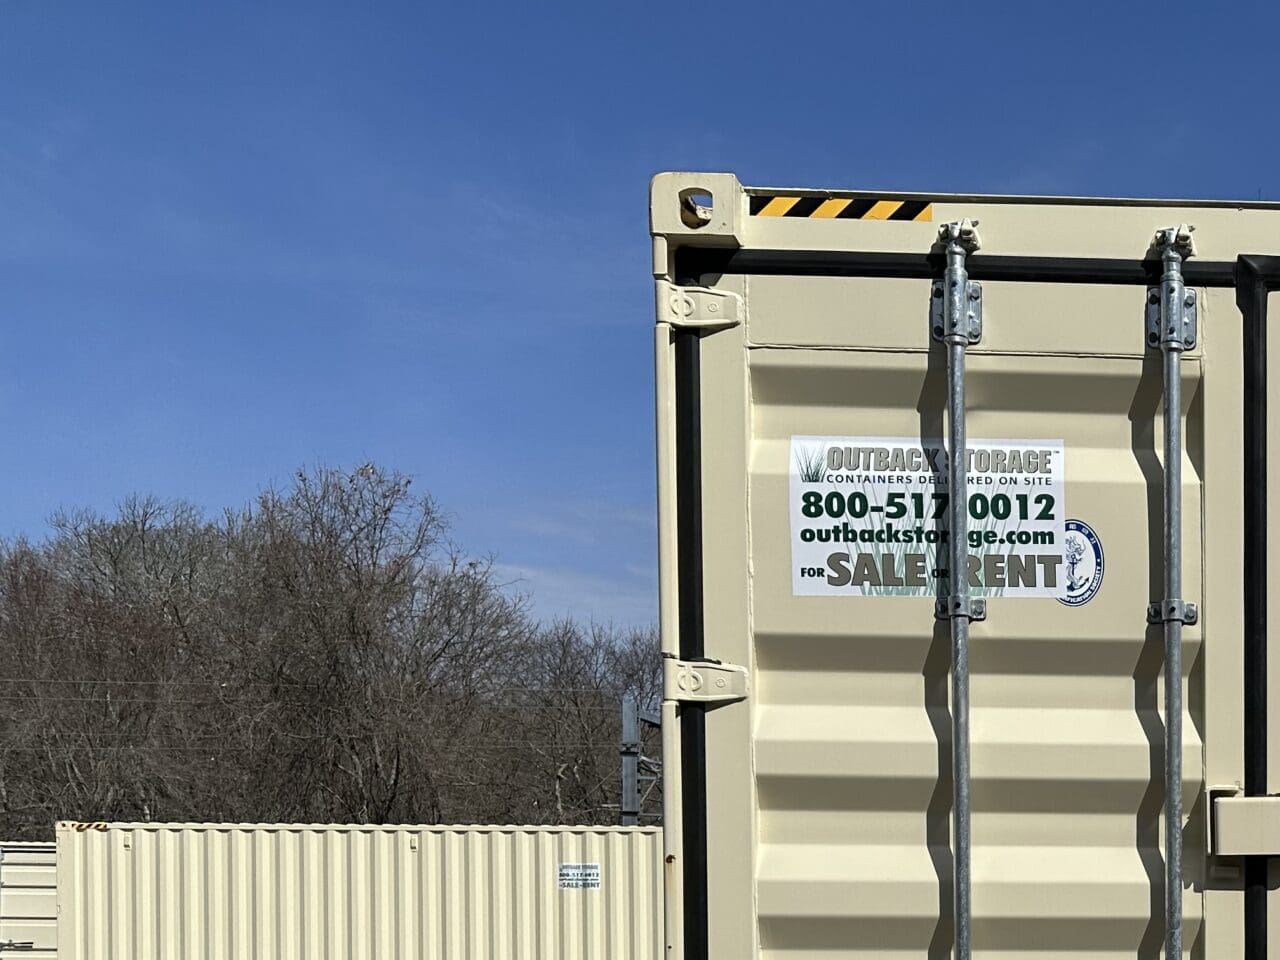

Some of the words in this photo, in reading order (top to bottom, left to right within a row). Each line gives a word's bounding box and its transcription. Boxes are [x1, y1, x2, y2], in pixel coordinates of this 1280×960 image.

[827, 446, 940, 473] OUTBACK
[944, 447, 1051, 474] TORAGE
[826, 474, 913, 485] CONTAINERS
[919, 475, 993, 485] DELIRED
[999, 476, 1018, 486] ON
[1024, 477, 1053, 487] SITE
[801, 491, 1055, 521] 800-5170012
[800, 522, 1055, 549] outbackstorge.com
[801, 567, 825, 579] FOR
[826, 552, 927, 588] SALE
[931, 568, 950, 579] OR
[966, 553, 1063, 589] RENT
